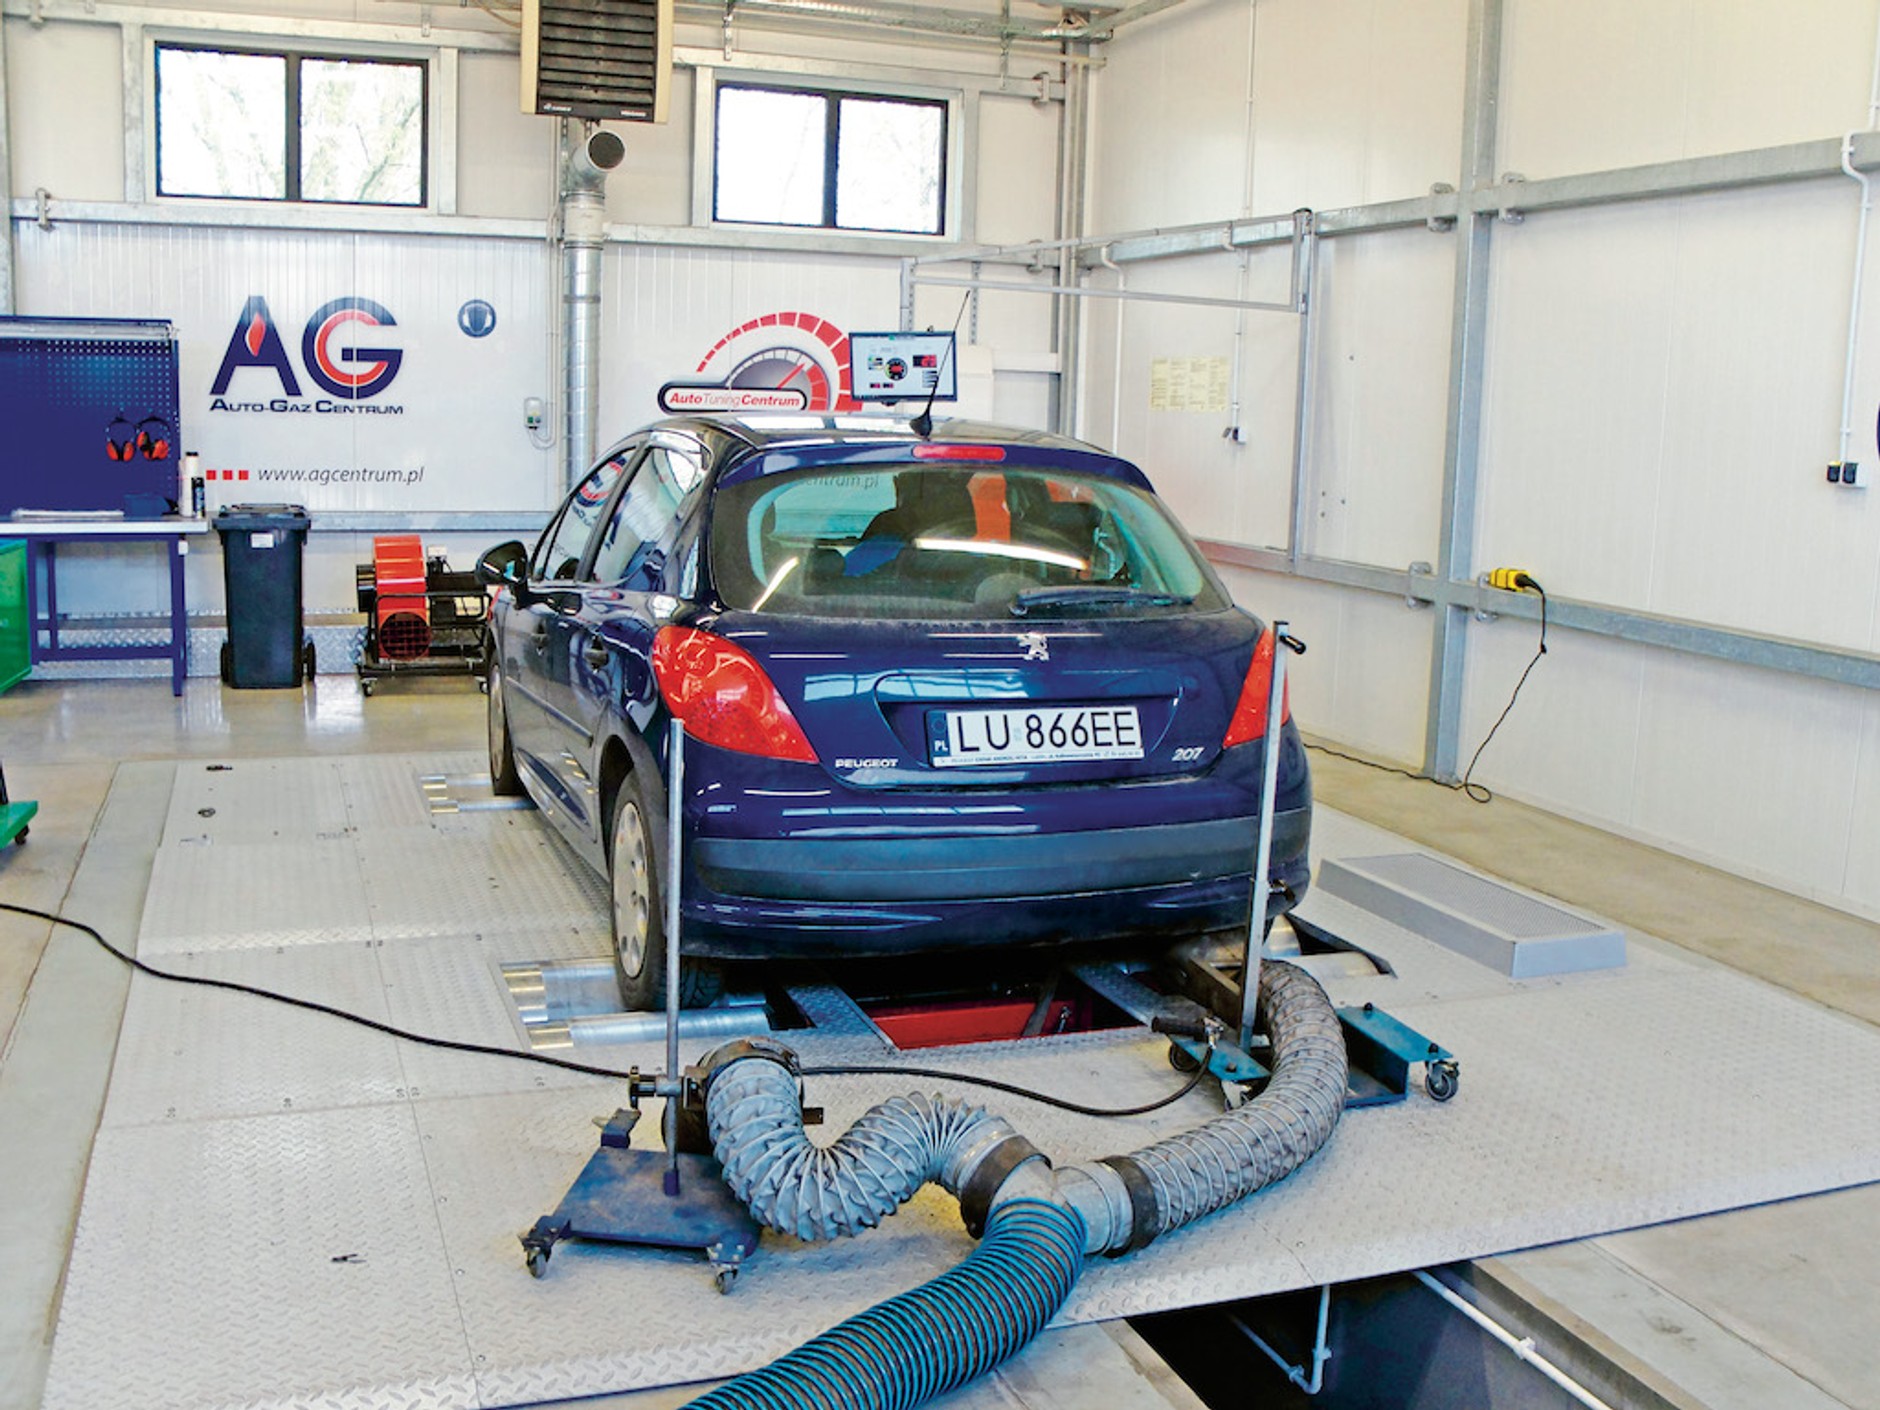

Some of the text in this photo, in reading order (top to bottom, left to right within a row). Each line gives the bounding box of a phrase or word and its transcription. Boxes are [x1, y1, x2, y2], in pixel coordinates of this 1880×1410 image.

[209, 295, 404, 400] AG
[258, 466, 425, 485] www.agcentrum.pl
[956, 711, 1137, 752] LU 866EE
[934, 740, 949, 752] PL
[1171, 747, 1205, 762] 207
[834, 758, 899, 769] PEUGEOT
